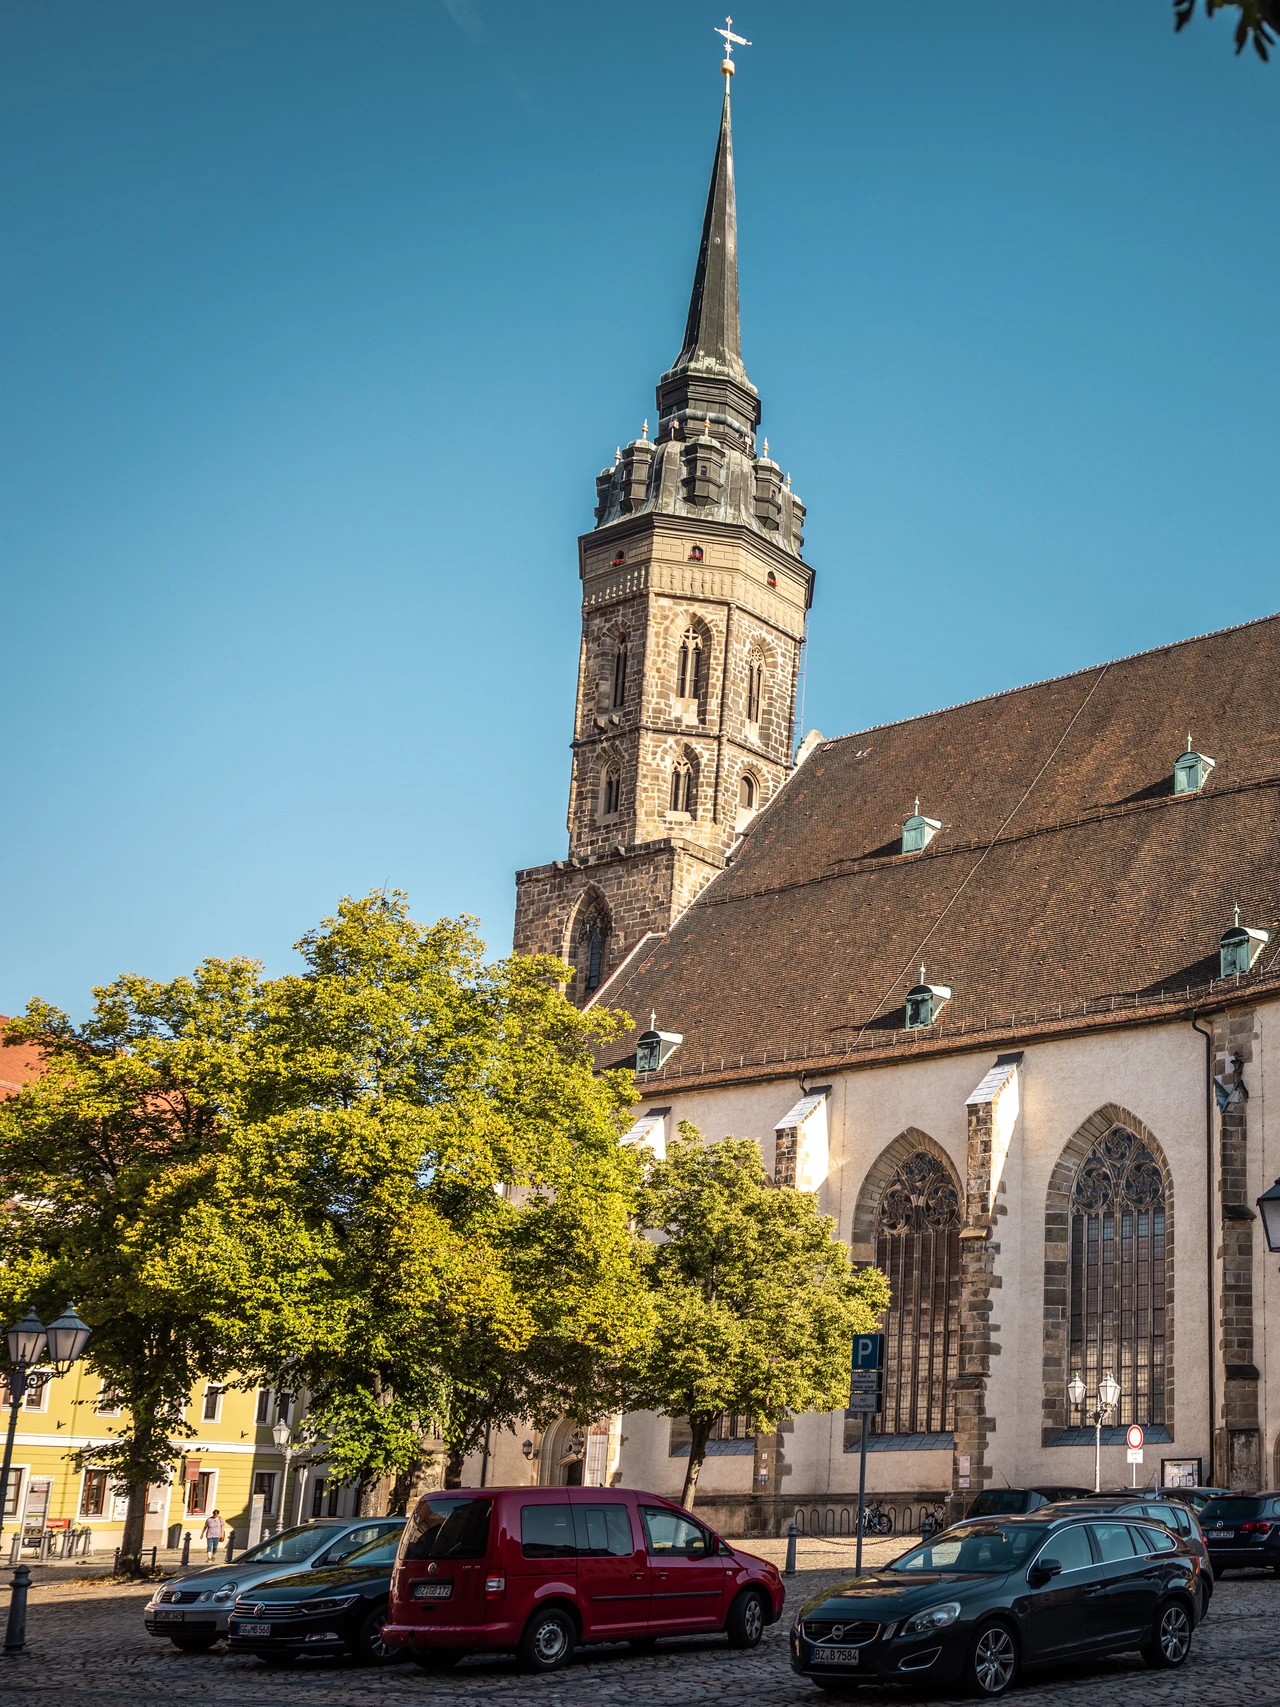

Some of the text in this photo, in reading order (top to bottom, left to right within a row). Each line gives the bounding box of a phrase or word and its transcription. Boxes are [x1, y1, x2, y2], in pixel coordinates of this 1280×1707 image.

[858, 1338, 872, 1366] P
[437, 1586, 451, 1595] 172
[258, 1626, 270, 1634] 568
[815, 1649, 825, 1660] BZ
[837, 1650, 857, 1661] 7584
